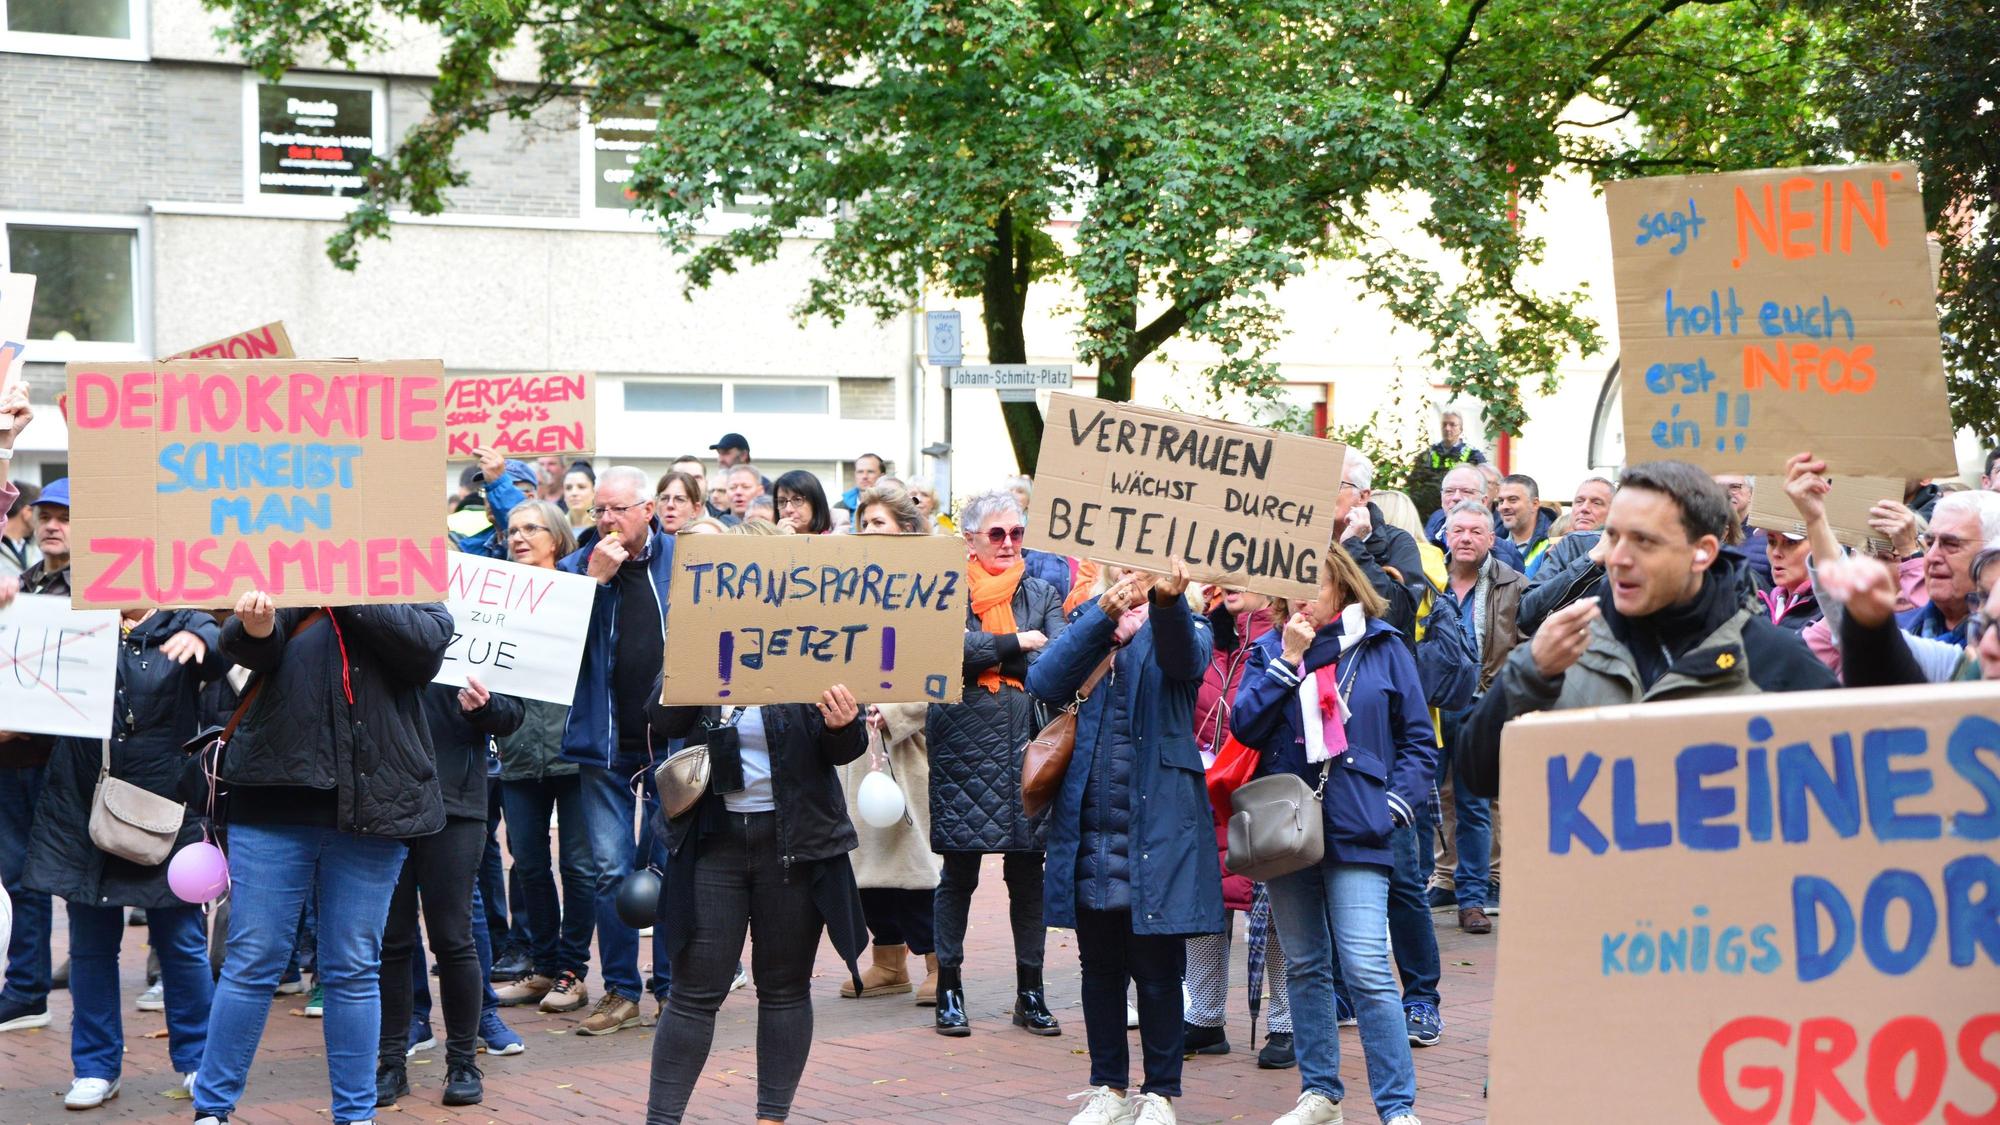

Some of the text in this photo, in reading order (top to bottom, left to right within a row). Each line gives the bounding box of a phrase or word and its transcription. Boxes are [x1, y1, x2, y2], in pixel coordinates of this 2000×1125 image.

[1635, 197, 1706, 255] sagt
[1666, 288, 1855, 340] holt euch
[953, 369, 1067, 385] Johann-Schmitz-Platz
[1645, 339, 1877, 395] erst INFOS
[75, 372, 440, 441] DEMOKRATIE
[496, 403, 550, 430] gibt's
[157, 441, 363, 493] SCHREIBT
[1069, 408, 1272, 480] VERTRAUEN
[210, 493, 332, 535] MAN
[1111, 470, 1314, 526] WÄCHST DURCH
[1048, 497, 1317, 584] BETEILIGUNG
[84, 536, 449, 603] ZUSAMMEN
[449, 563, 554, 614] NEIN
[684, 562, 960, 611] TRANSPARENZ
[471, 610, 506, 627] ZUR
[0, 624, 95, 695] UE
